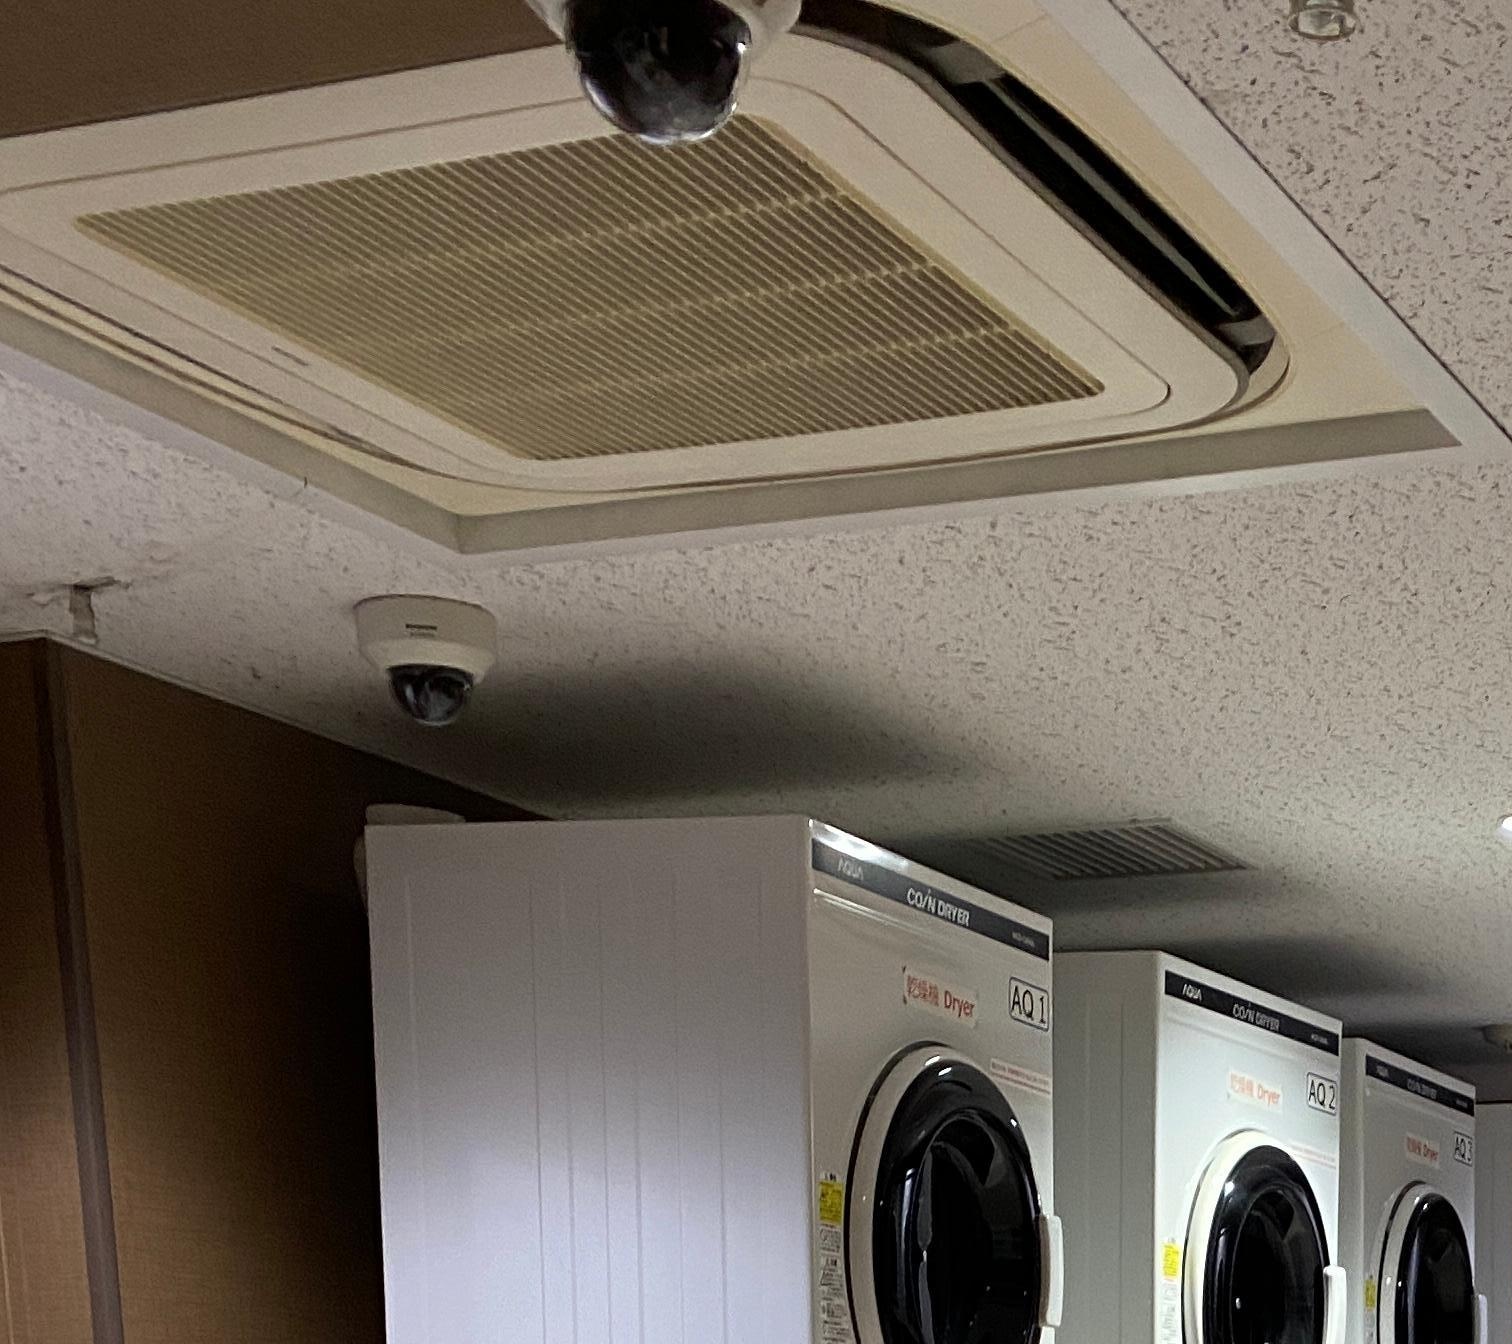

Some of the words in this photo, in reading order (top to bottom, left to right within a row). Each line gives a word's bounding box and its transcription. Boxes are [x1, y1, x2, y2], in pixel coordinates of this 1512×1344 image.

[937, 900, 970, 926] DRYER
[944, 990, 976, 1018] Dryer
[1011, 985, 1034, 1021] AQ
[1039, 995, 1046, 1024] 1
[1257, 1083, 1280, 1106] Dryer
[1308, 1079, 1327, 1107] AQ
[1329, 1085, 1336, 1110] 2
[1454, 1136, 1467, 1160] AQ
